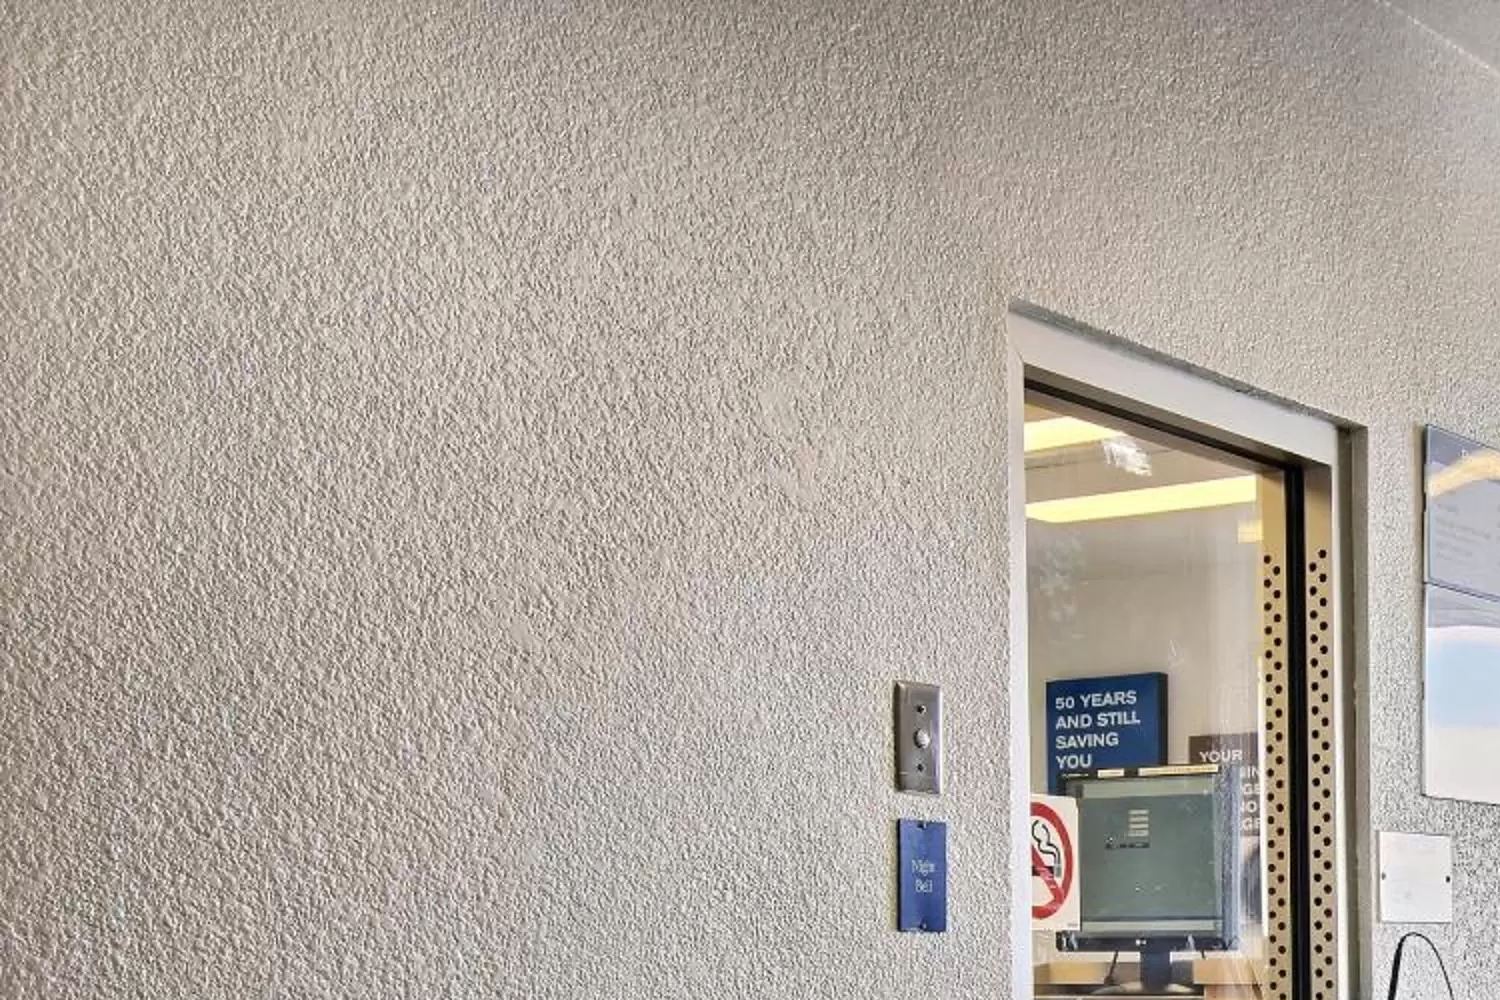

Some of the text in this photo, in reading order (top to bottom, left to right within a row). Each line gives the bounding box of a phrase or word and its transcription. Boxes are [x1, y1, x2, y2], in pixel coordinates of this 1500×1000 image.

[1055, 690, 1137, 710] 50 YEARS
[1055, 710, 1141, 730] AND STILL
[1055, 732, 1119, 749] SAVING
[1055, 753, 1092, 769] YOU
[1199, 749, 1243, 763] YOUR
